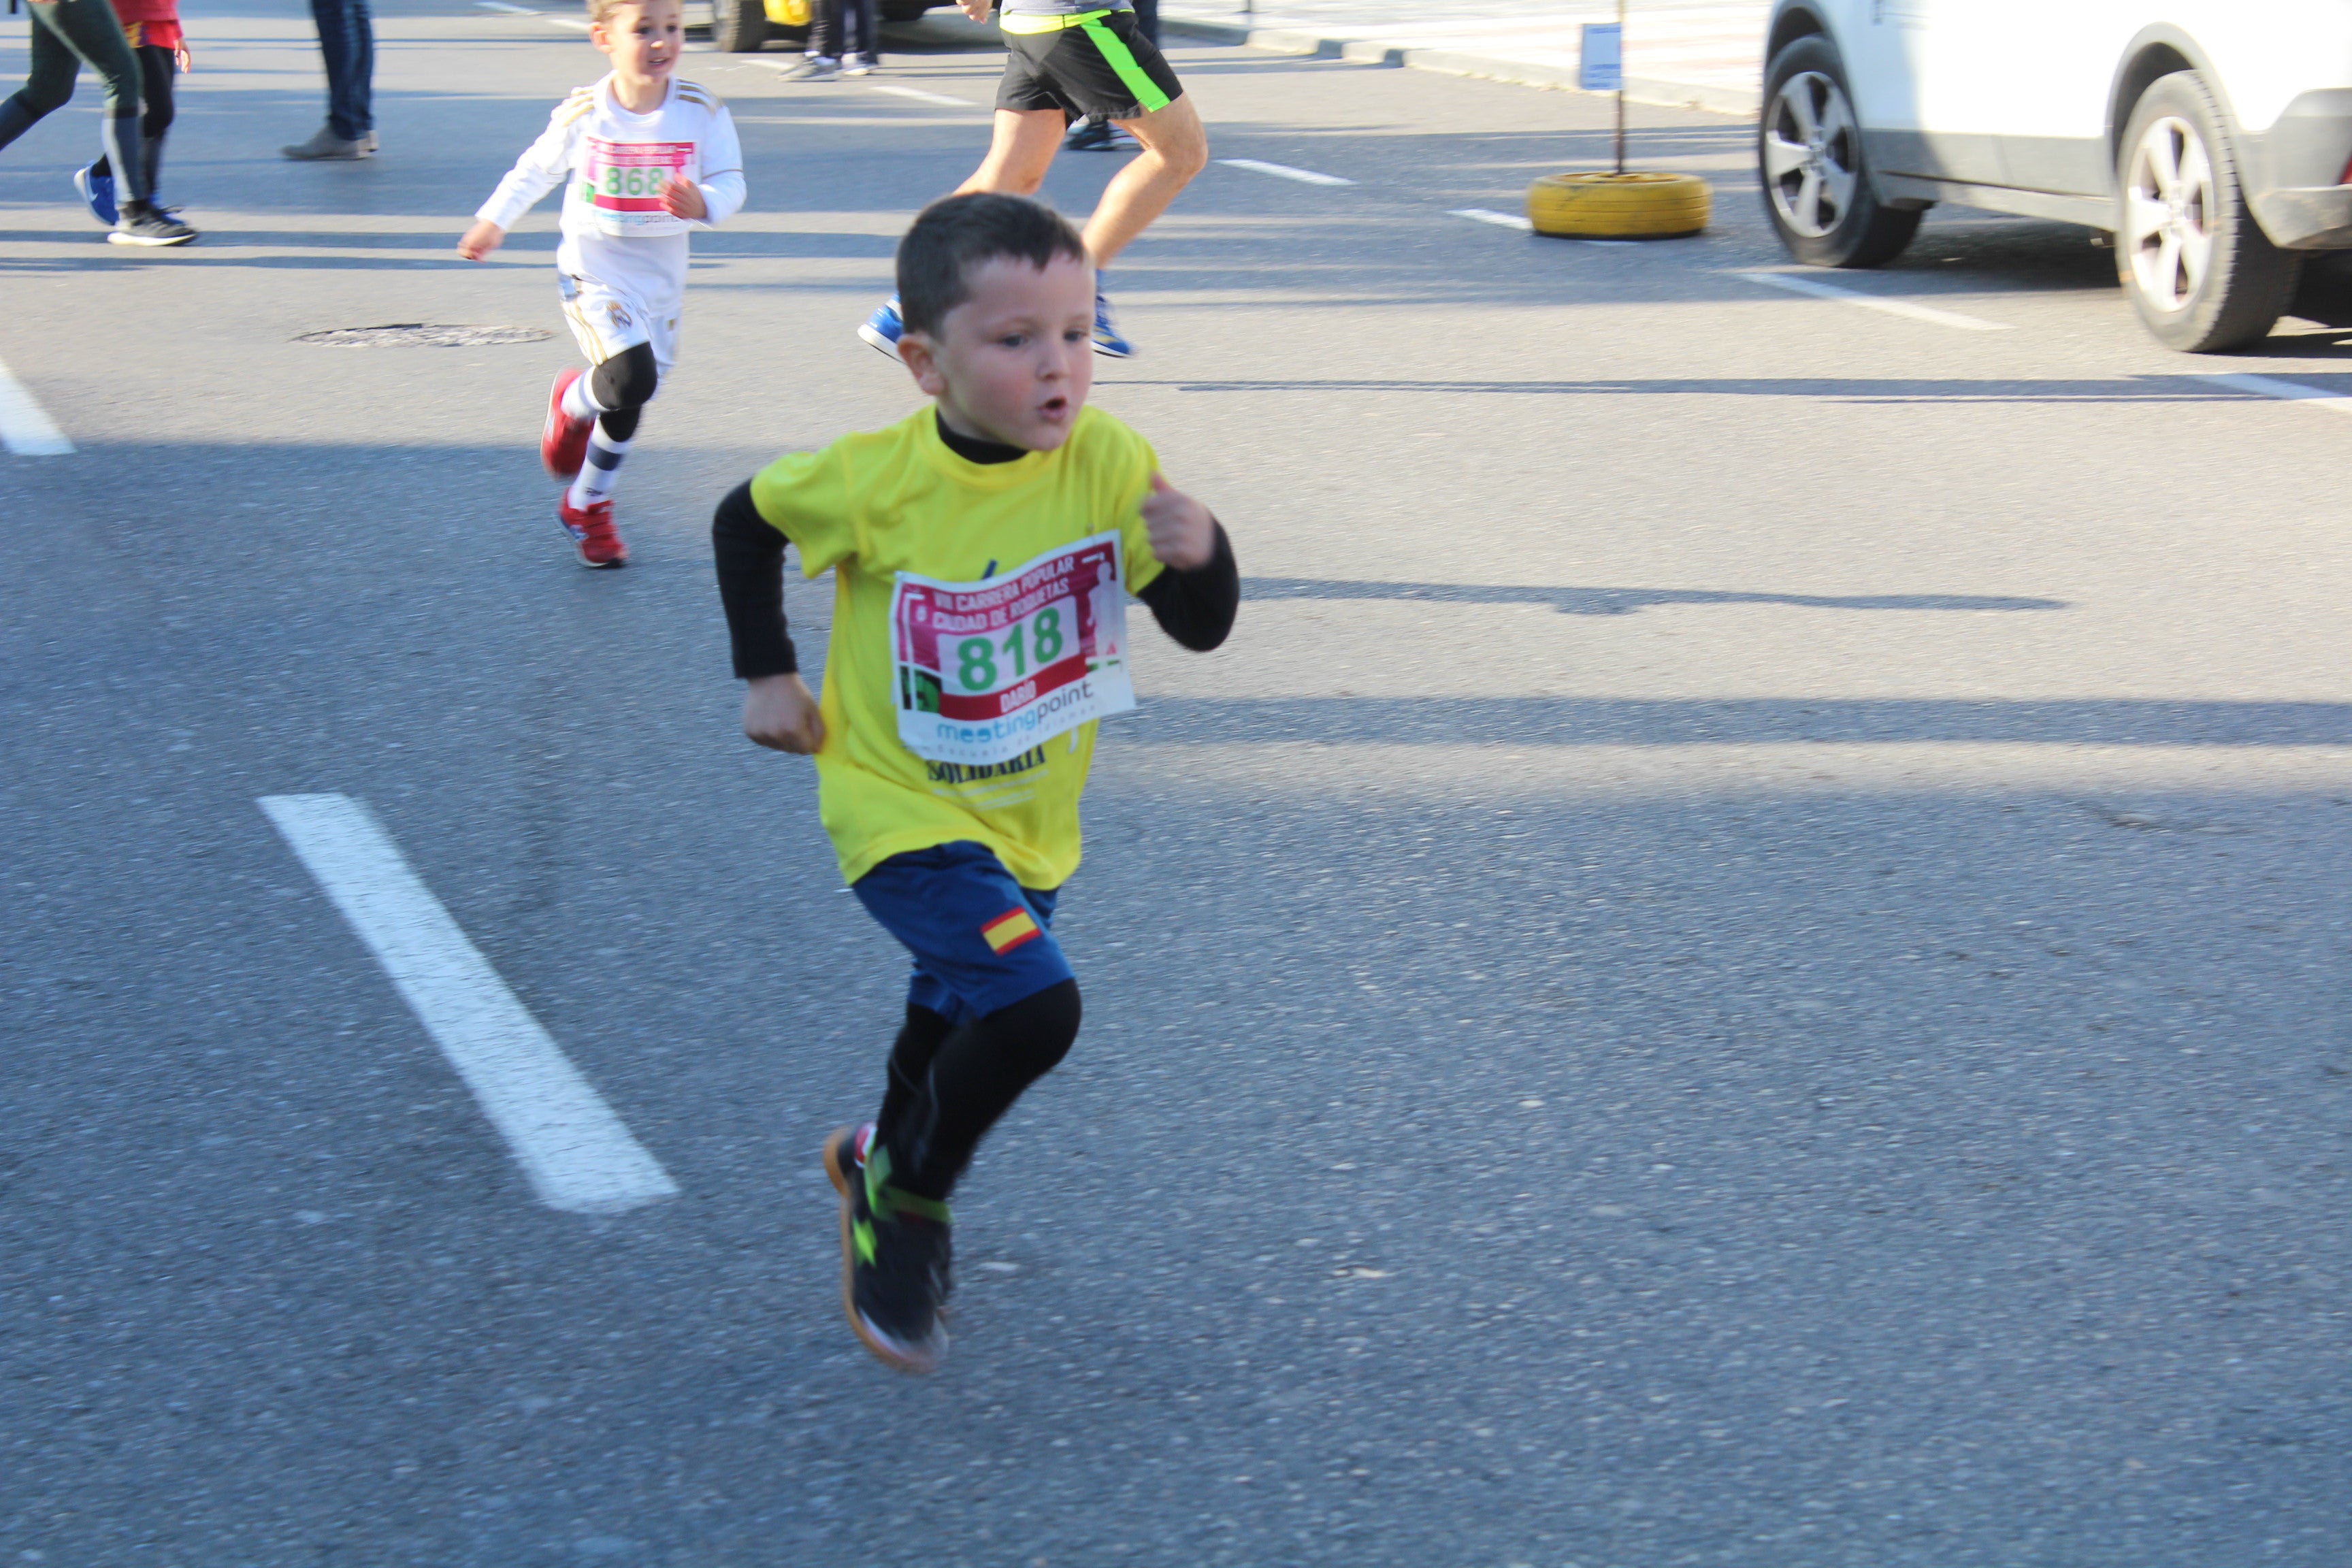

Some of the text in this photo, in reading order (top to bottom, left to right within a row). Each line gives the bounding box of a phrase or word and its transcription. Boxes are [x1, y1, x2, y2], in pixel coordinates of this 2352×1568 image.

[606, 167, 664, 195] 868
[932, 577, 1070, 632] CIUDAD DE ROQUETAS
[956, 582, 1021, 611] CARRERA
[1021, 555, 1075, 593] POPULAR
[957, 607, 1064, 691] 818
[936, 679, 1094, 743] meetingpoint
